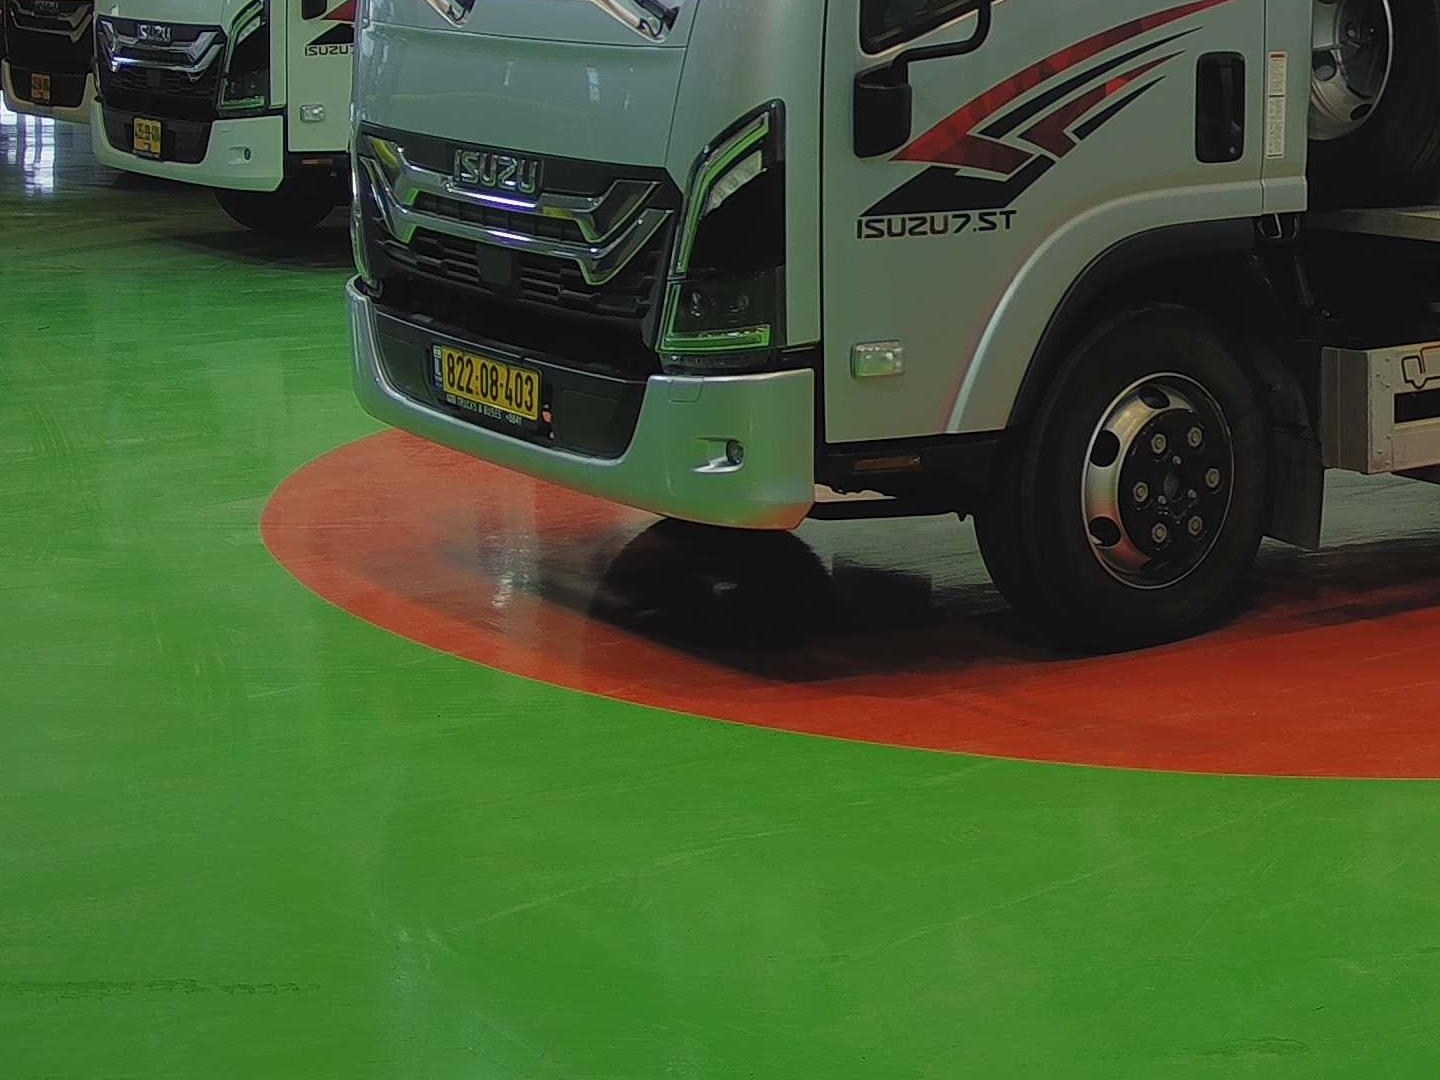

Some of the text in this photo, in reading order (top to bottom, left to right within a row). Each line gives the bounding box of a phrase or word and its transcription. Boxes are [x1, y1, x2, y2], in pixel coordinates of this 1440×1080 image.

[304, 44, 349, 56] ISUZU
[454, 149, 537, 194] ISUZU
[856, 214, 949, 239] ISUZU
